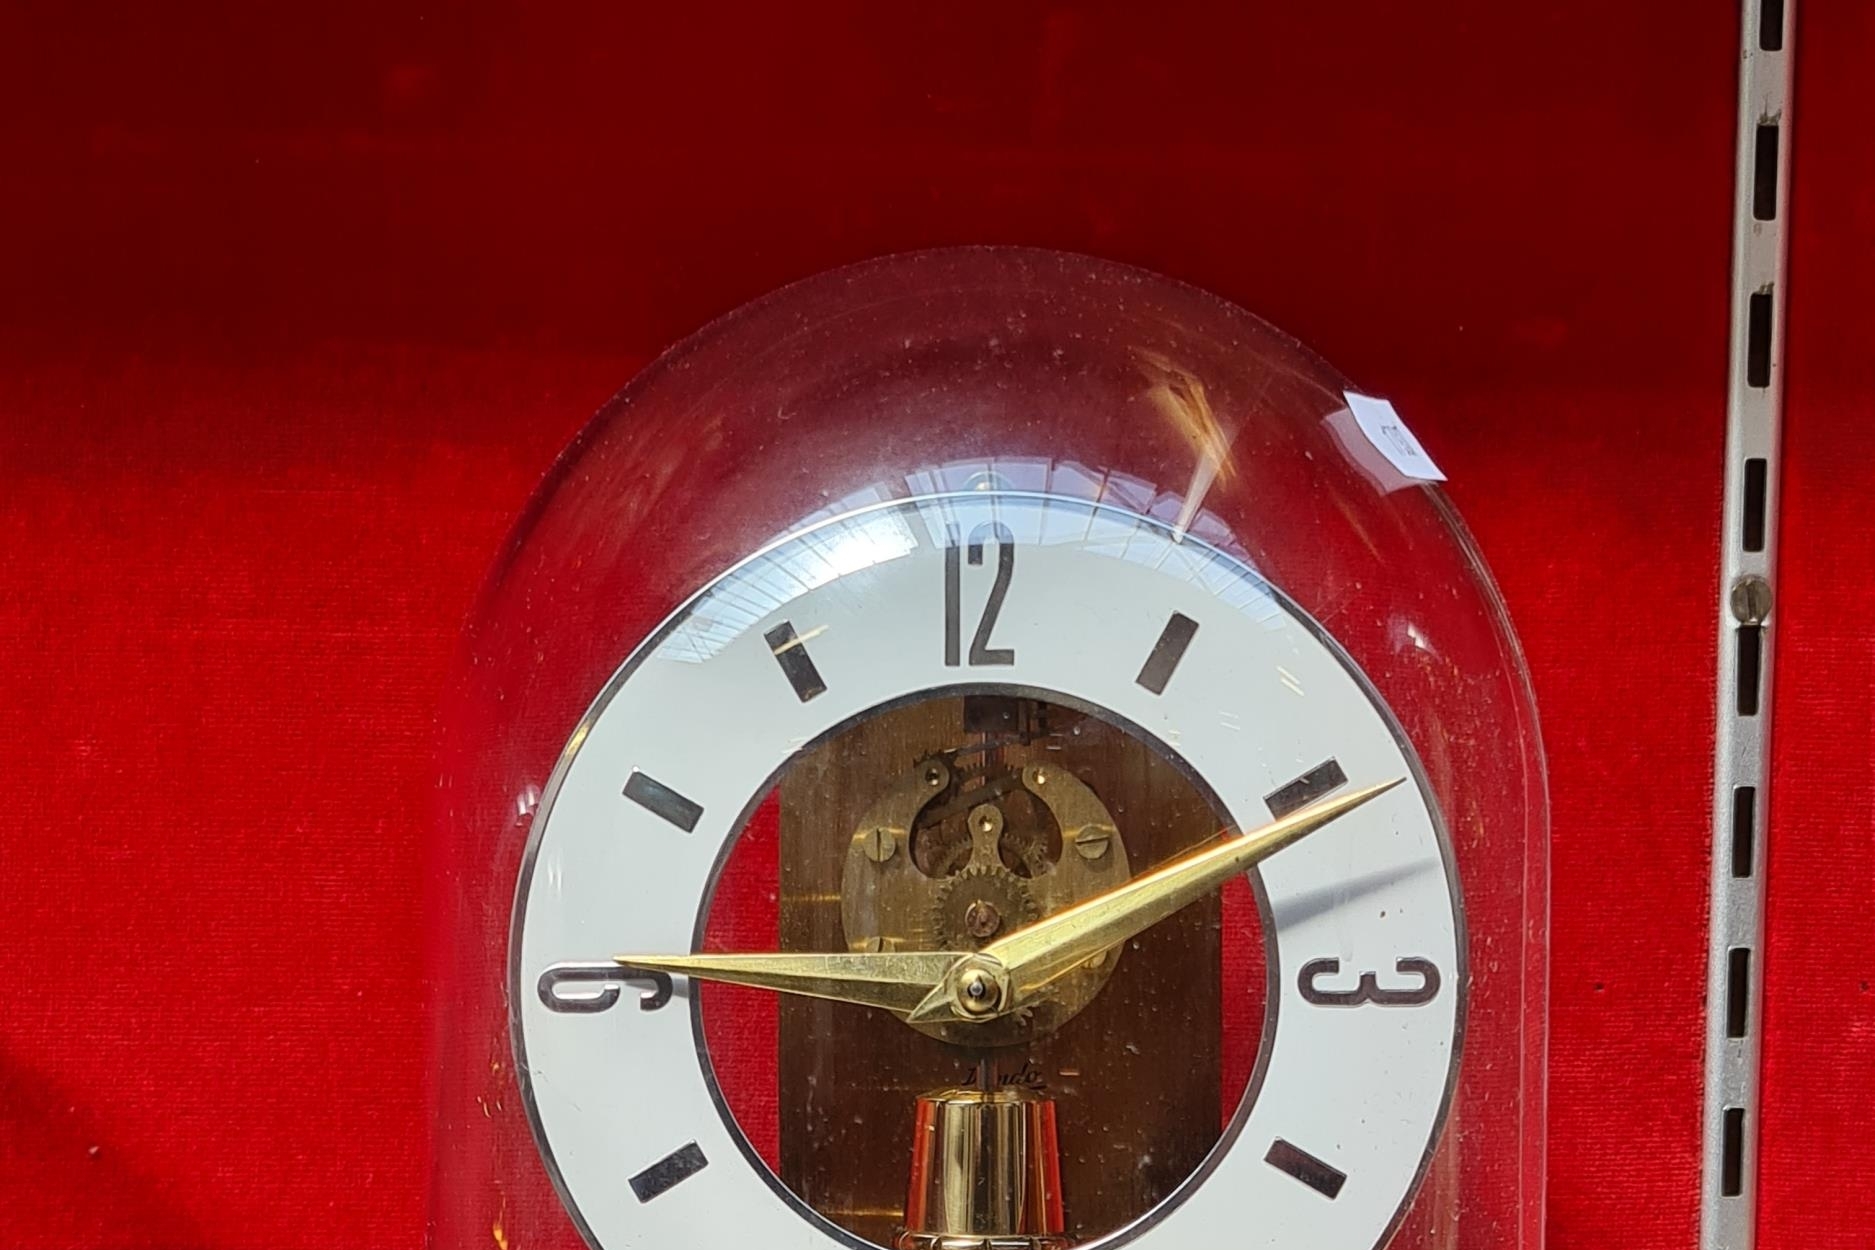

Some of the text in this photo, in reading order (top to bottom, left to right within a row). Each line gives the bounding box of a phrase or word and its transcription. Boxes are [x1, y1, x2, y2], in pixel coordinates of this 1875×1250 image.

[944, 521, 1016, 667] 12
[537, 966, 673, 1014] 9
[1298, 956, 1441, 1009] 3
